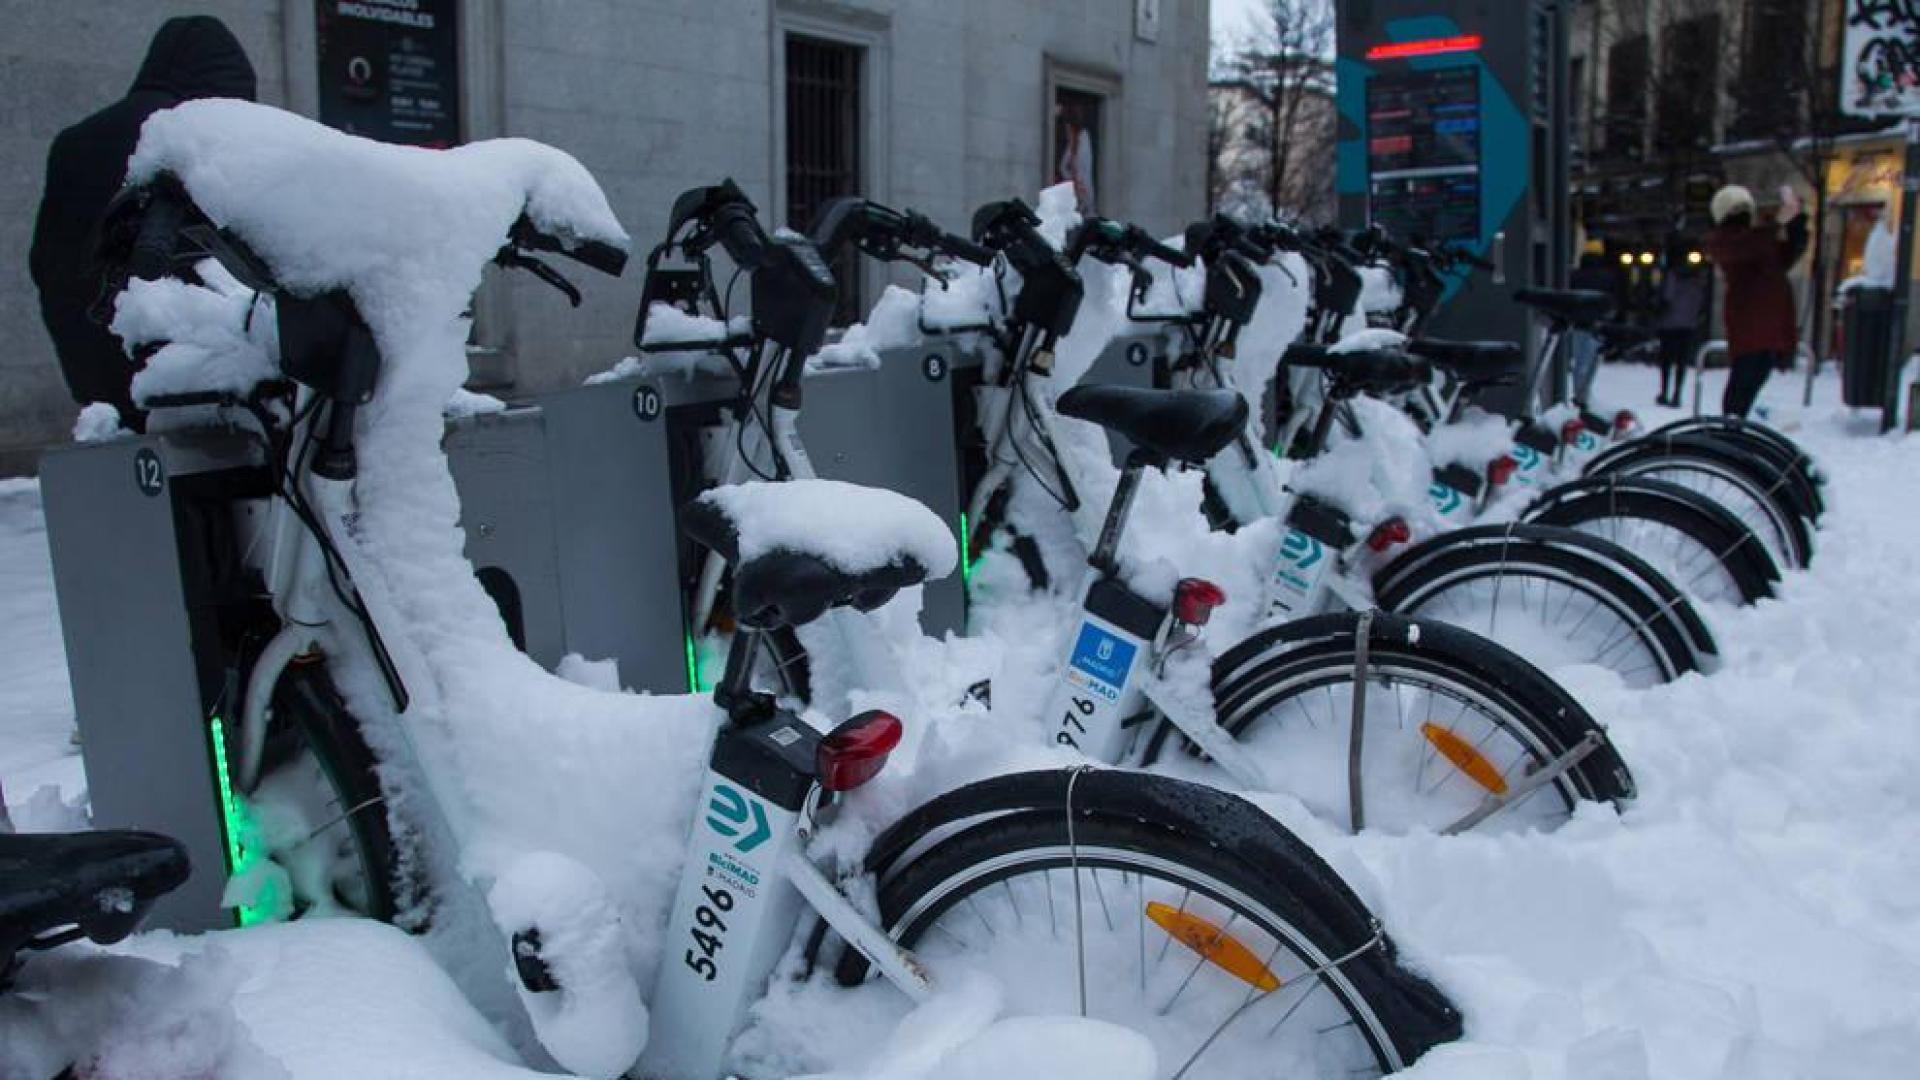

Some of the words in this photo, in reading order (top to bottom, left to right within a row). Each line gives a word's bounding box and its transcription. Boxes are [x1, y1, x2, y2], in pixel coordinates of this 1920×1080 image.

[929, 359, 940, 376] 8
[637, 392, 657, 415] 10
[139, 459, 160, 487] 12
[1057, 696, 1095, 750] 976
[685, 884, 734, 981] 5496
